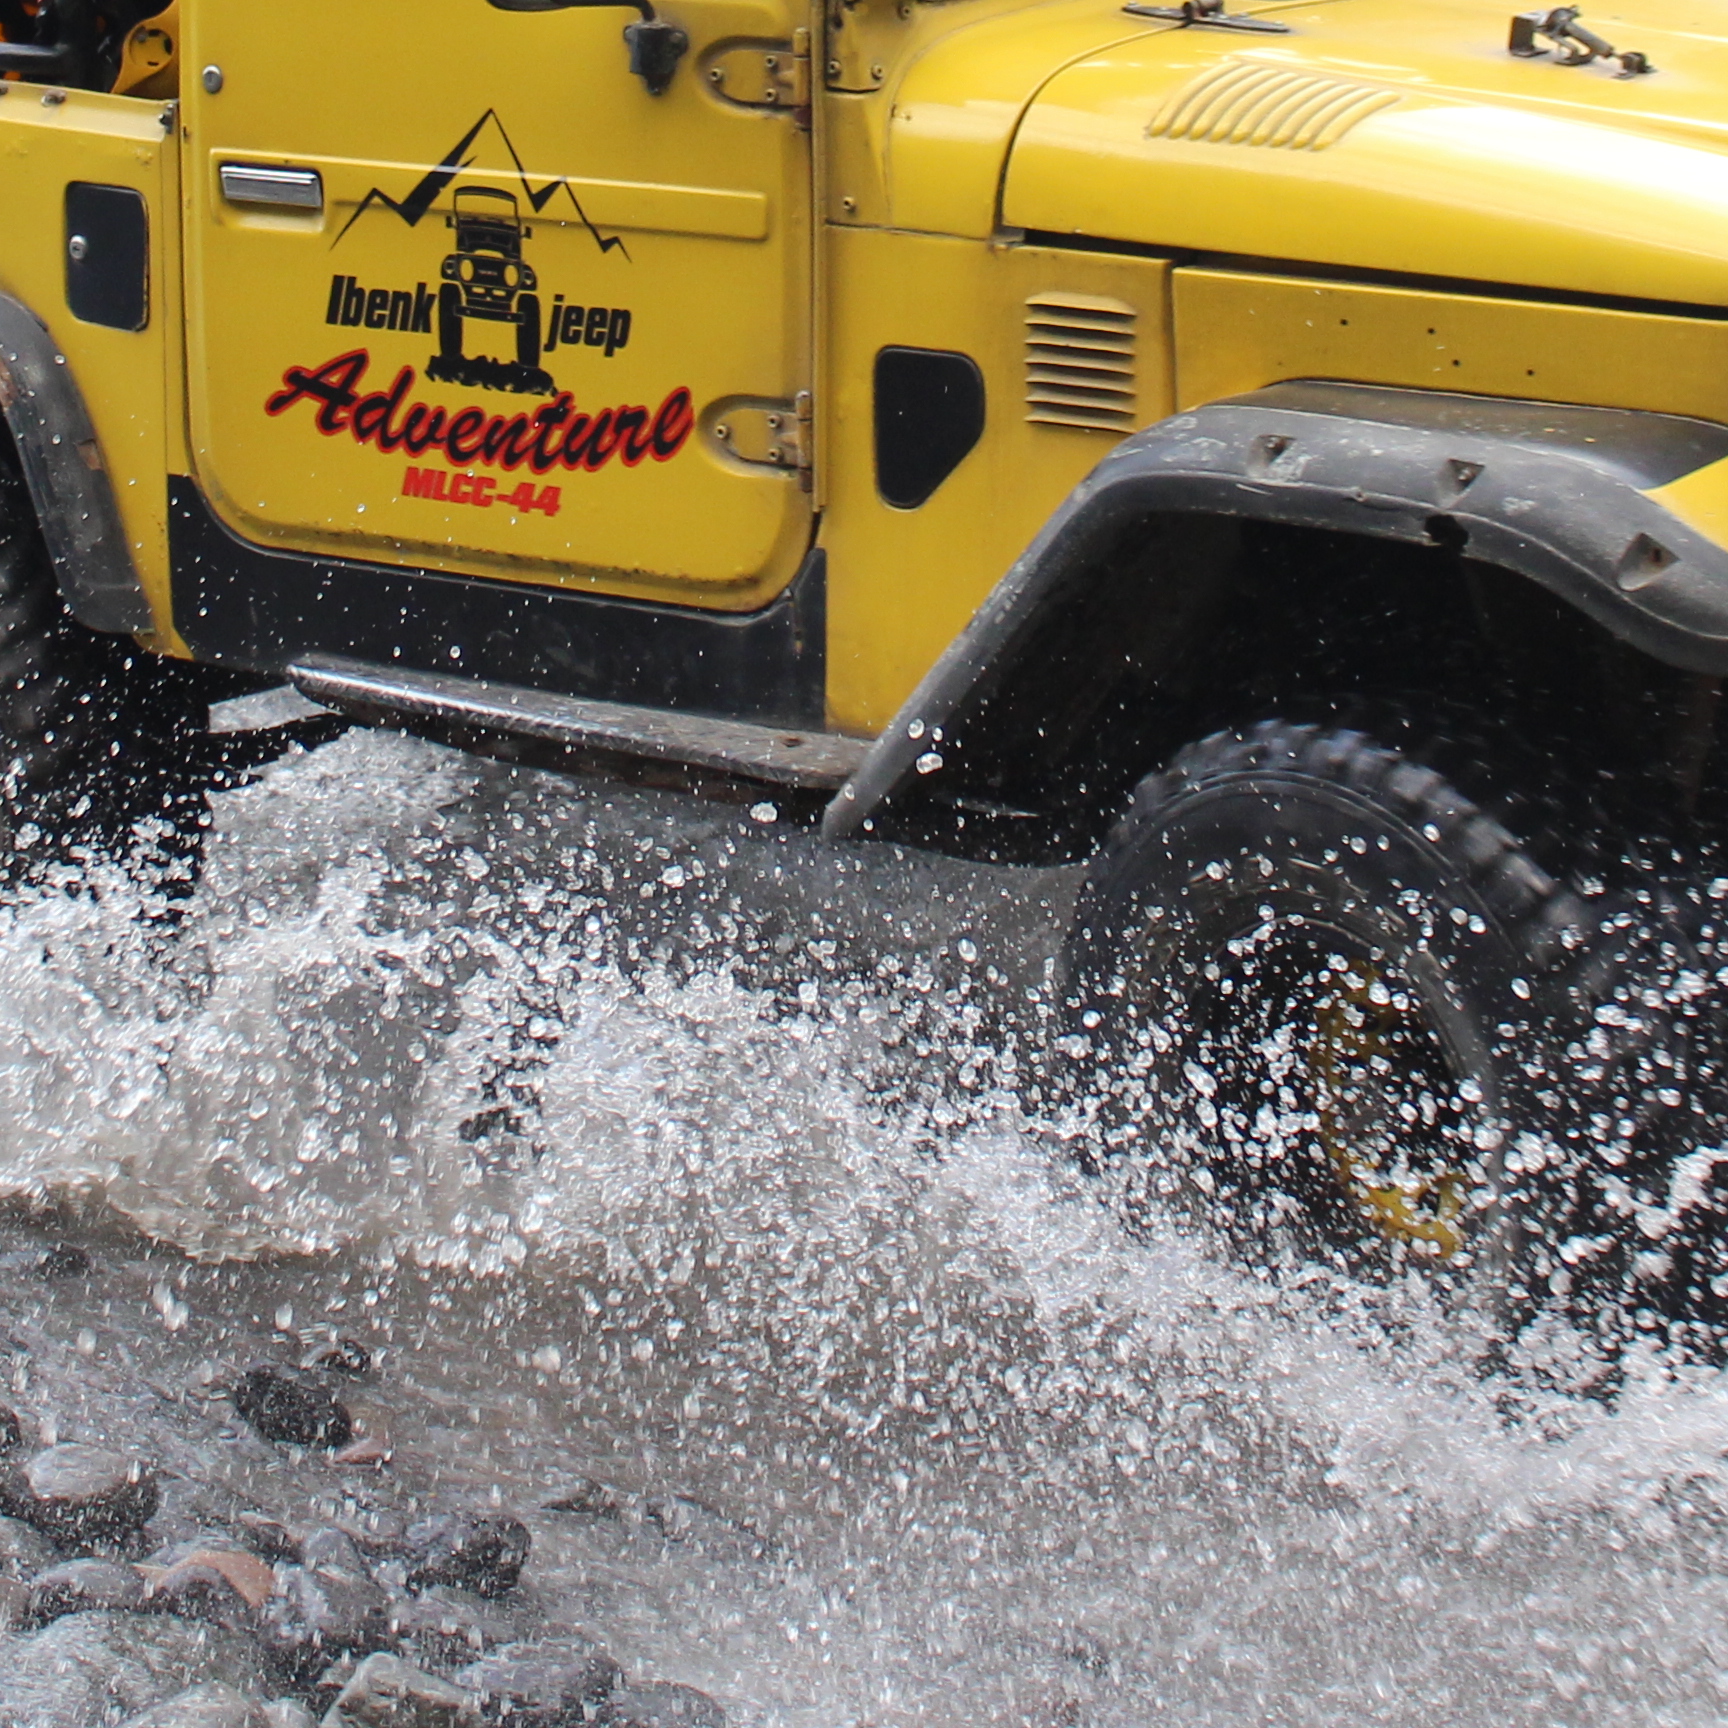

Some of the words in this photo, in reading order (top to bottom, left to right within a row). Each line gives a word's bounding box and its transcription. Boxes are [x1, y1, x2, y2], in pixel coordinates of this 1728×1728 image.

[325, 274, 437, 334] Ibenk
[543, 294, 632, 358] jeep
[264, 348, 695, 474] Adventure
[401, 466, 562, 517] MLCC-44
